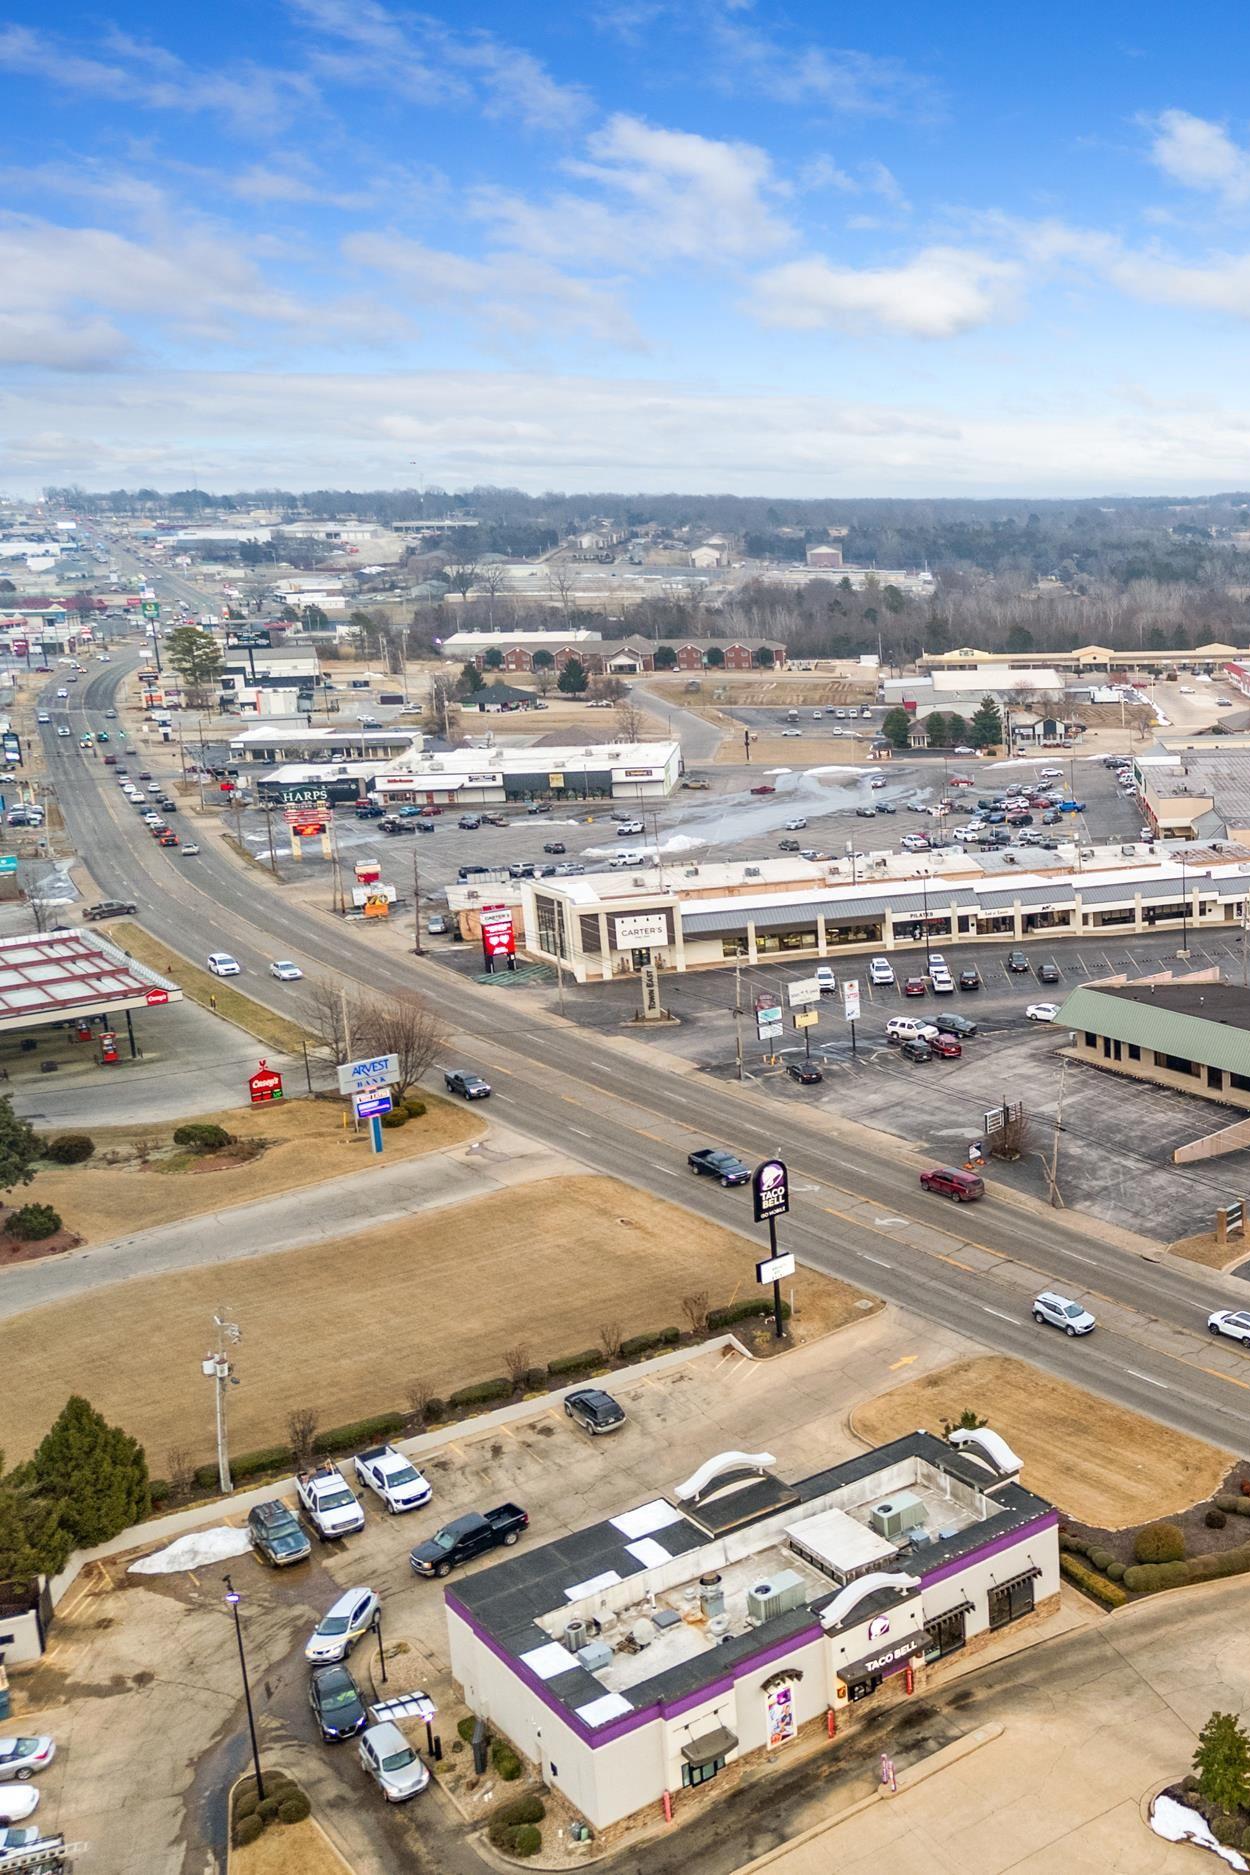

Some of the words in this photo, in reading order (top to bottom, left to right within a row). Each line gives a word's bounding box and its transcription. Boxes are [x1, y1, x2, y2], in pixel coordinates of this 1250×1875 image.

[283, 790, 328, 802] HARPS
[621, 926, 663, 937] CARTER'S
[352, 1059, 389, 1077] ARVEST
[760, 1186, 785, 1201] TACO
[762, 1196, 785, 1210] BELL
[864, 1654, 893, 1671] TACO
[894, 1640, 917, 1659] BELL
